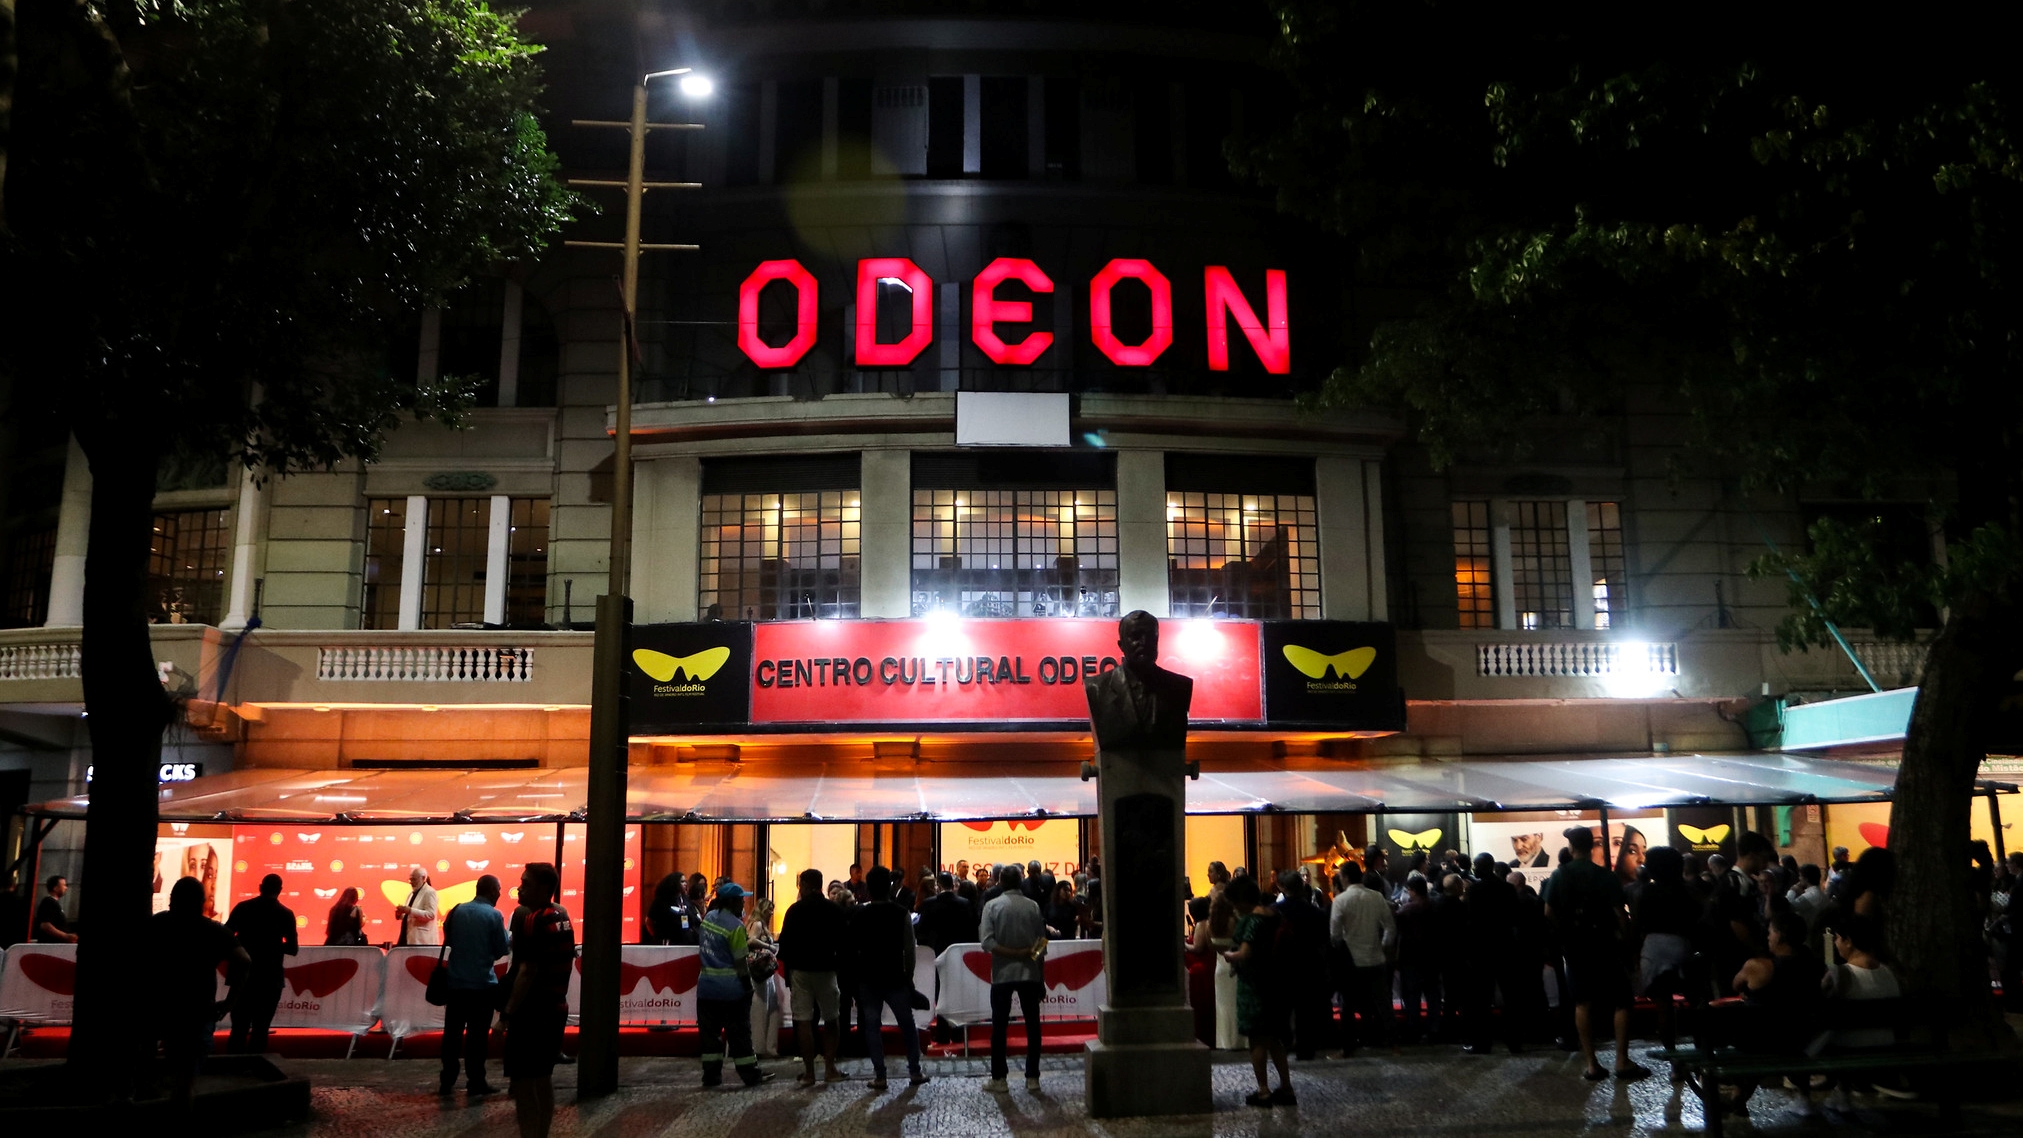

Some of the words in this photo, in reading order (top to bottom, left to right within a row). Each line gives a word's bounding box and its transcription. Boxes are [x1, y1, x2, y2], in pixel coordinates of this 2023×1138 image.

[738, 257, 1291, 375] ODEON
[757, 658, 875, 687] CENTRO
[880, 656, 1031, 686] CULTURAL
[1038, 656, 1125, 686] ODEO
[653, 684, 706, 693] FestivaldoRio
[968, 835, 1035, 846] FestivaldoRio
